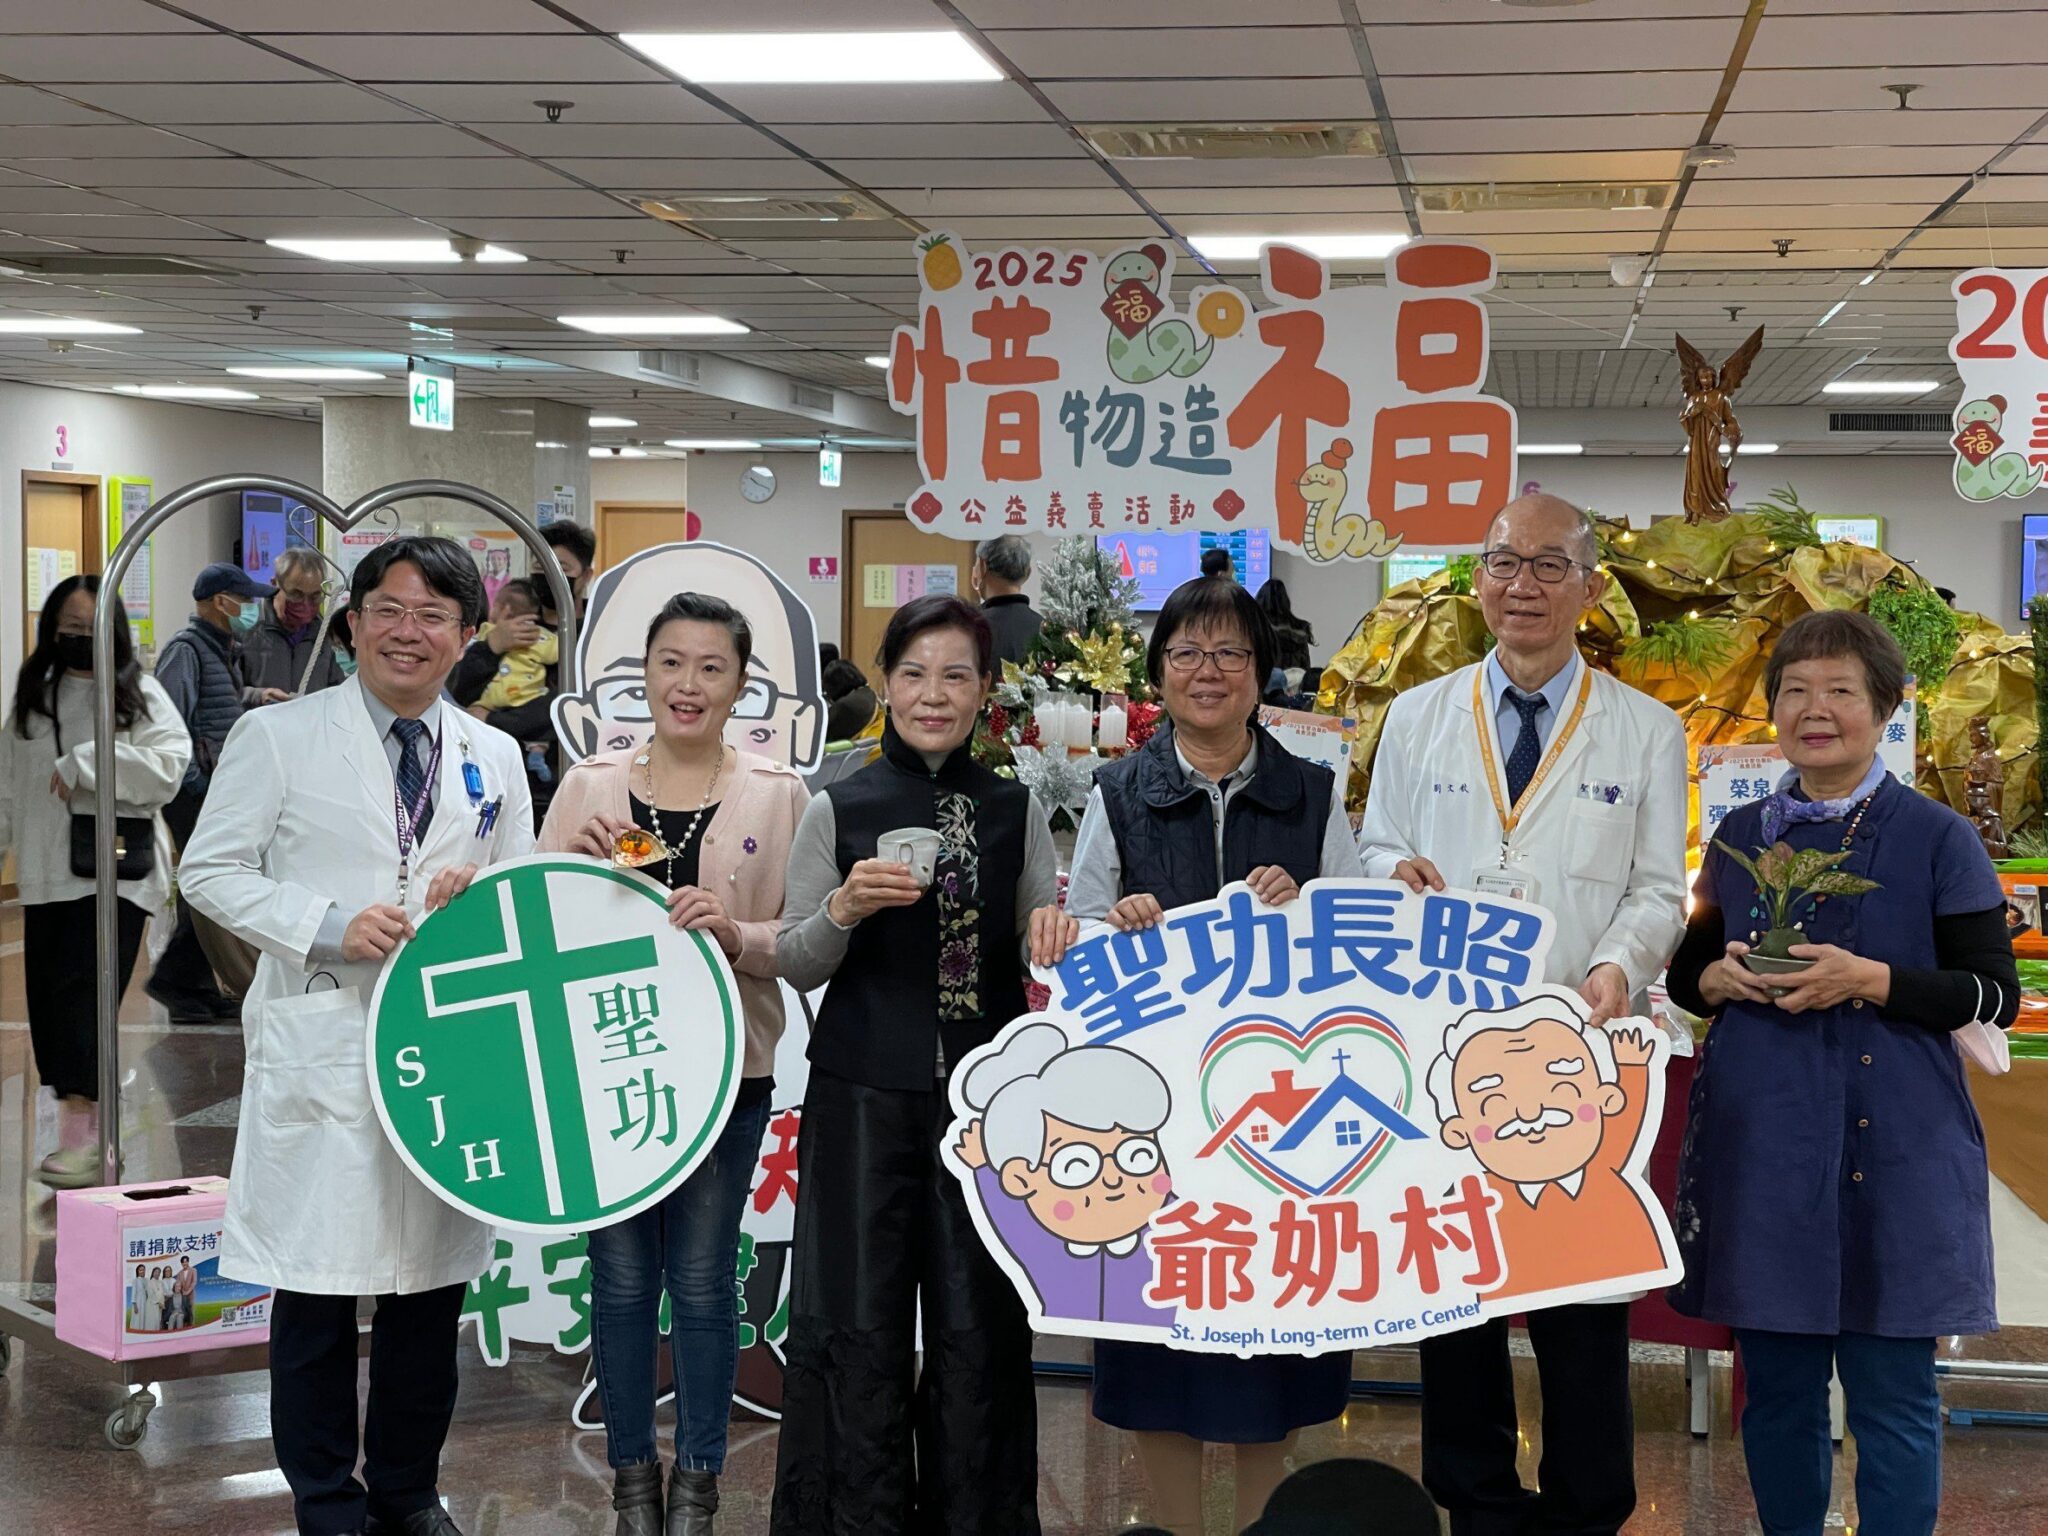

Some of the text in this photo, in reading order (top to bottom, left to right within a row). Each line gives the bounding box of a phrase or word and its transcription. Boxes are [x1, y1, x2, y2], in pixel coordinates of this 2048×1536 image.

[974, 251, 1087, 290] 2025
[1113, 290, 1151, 324] 福
[56, 425, 67, 457] 3
[1963, 429, 1994, 455] 福
[960, 489, 1195, 529] 公益義賣活動
[1878, 722, 1907, 744] 麥
[1730, 778, 1771, 799] 榮泉
[1054, 889, 1543, 1046] 聖功長照
[588, 982, 680, 1152] 聖功
[129, 1233, 217, 1257] 請捐款支持
[1149, 1175, 1502, 1311] 爺奶村
[1170, 1302, 1481, 1348] St. Joseph Long-term Care Center
